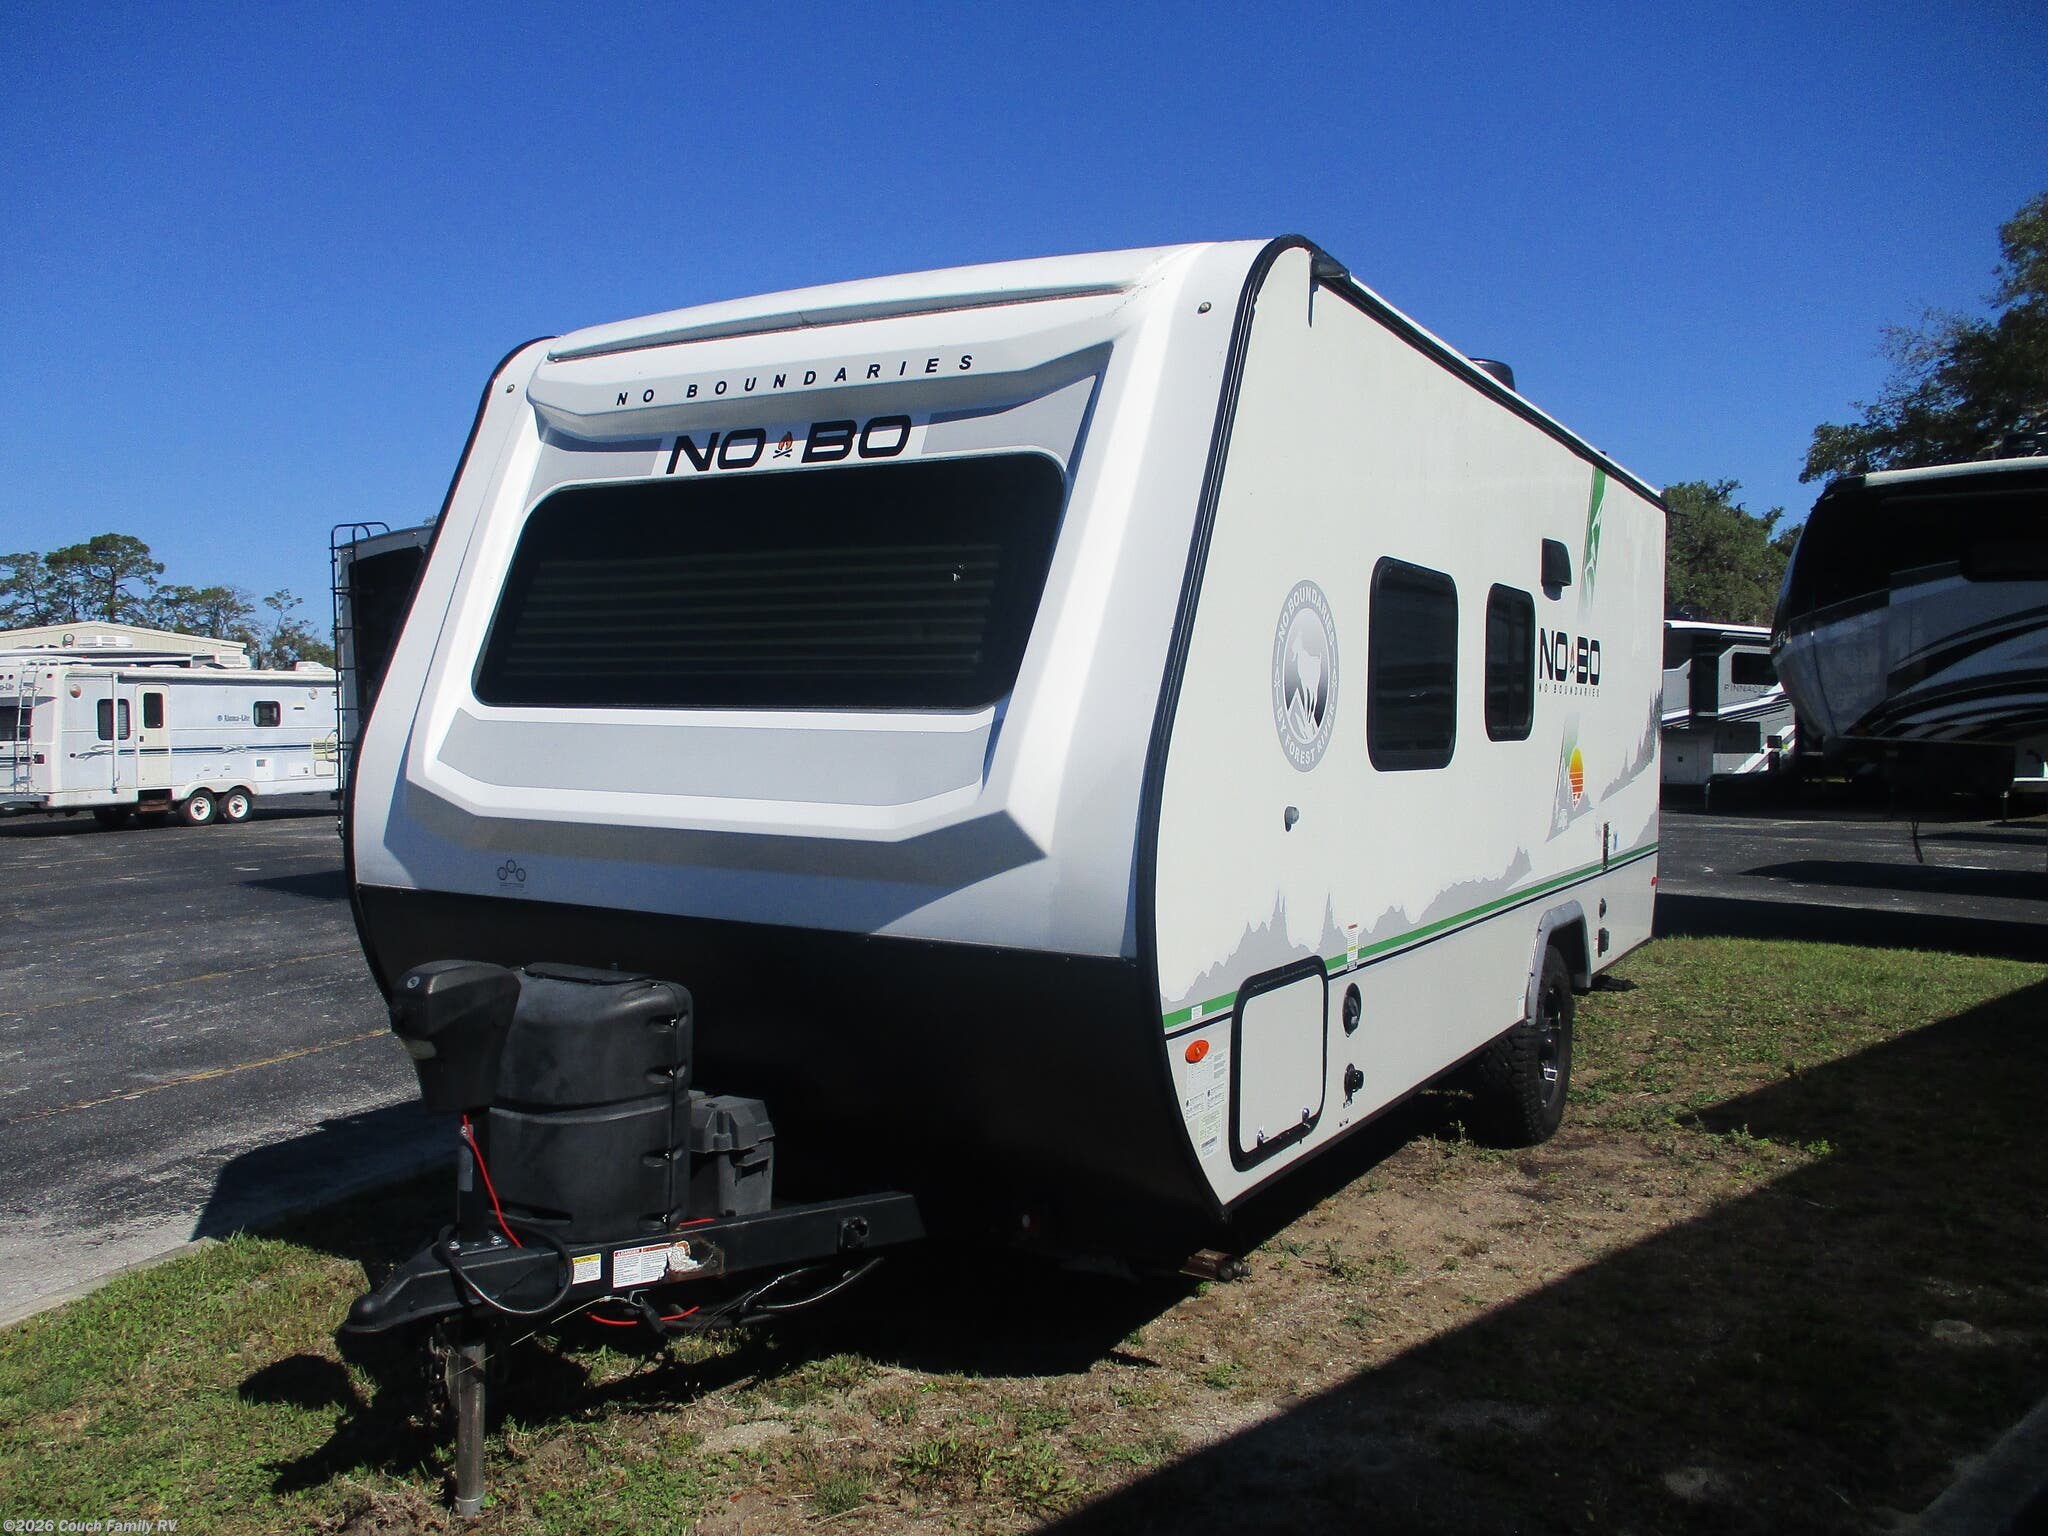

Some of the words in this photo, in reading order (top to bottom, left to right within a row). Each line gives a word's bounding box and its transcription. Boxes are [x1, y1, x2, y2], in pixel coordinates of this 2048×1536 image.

[616, 389, 655, 406] NO
[686, 354, 974, 399] BOUNDARIES
[665, 428, 767, 475] NO
[801, 415, 912, 464] BO
[1278, 614, 1290, 642] NO
[1288, 586, 1336, 647] BOUNDARIES
[1539, 627, 1568, 682] NO
[1576, 636, 1600, 686] BO
[1553, 684, 1600, 697] BOUNDARIES
[1284, 735, 1316, 765] FOREST
[1316, 704, 1336, 754] RIVER
